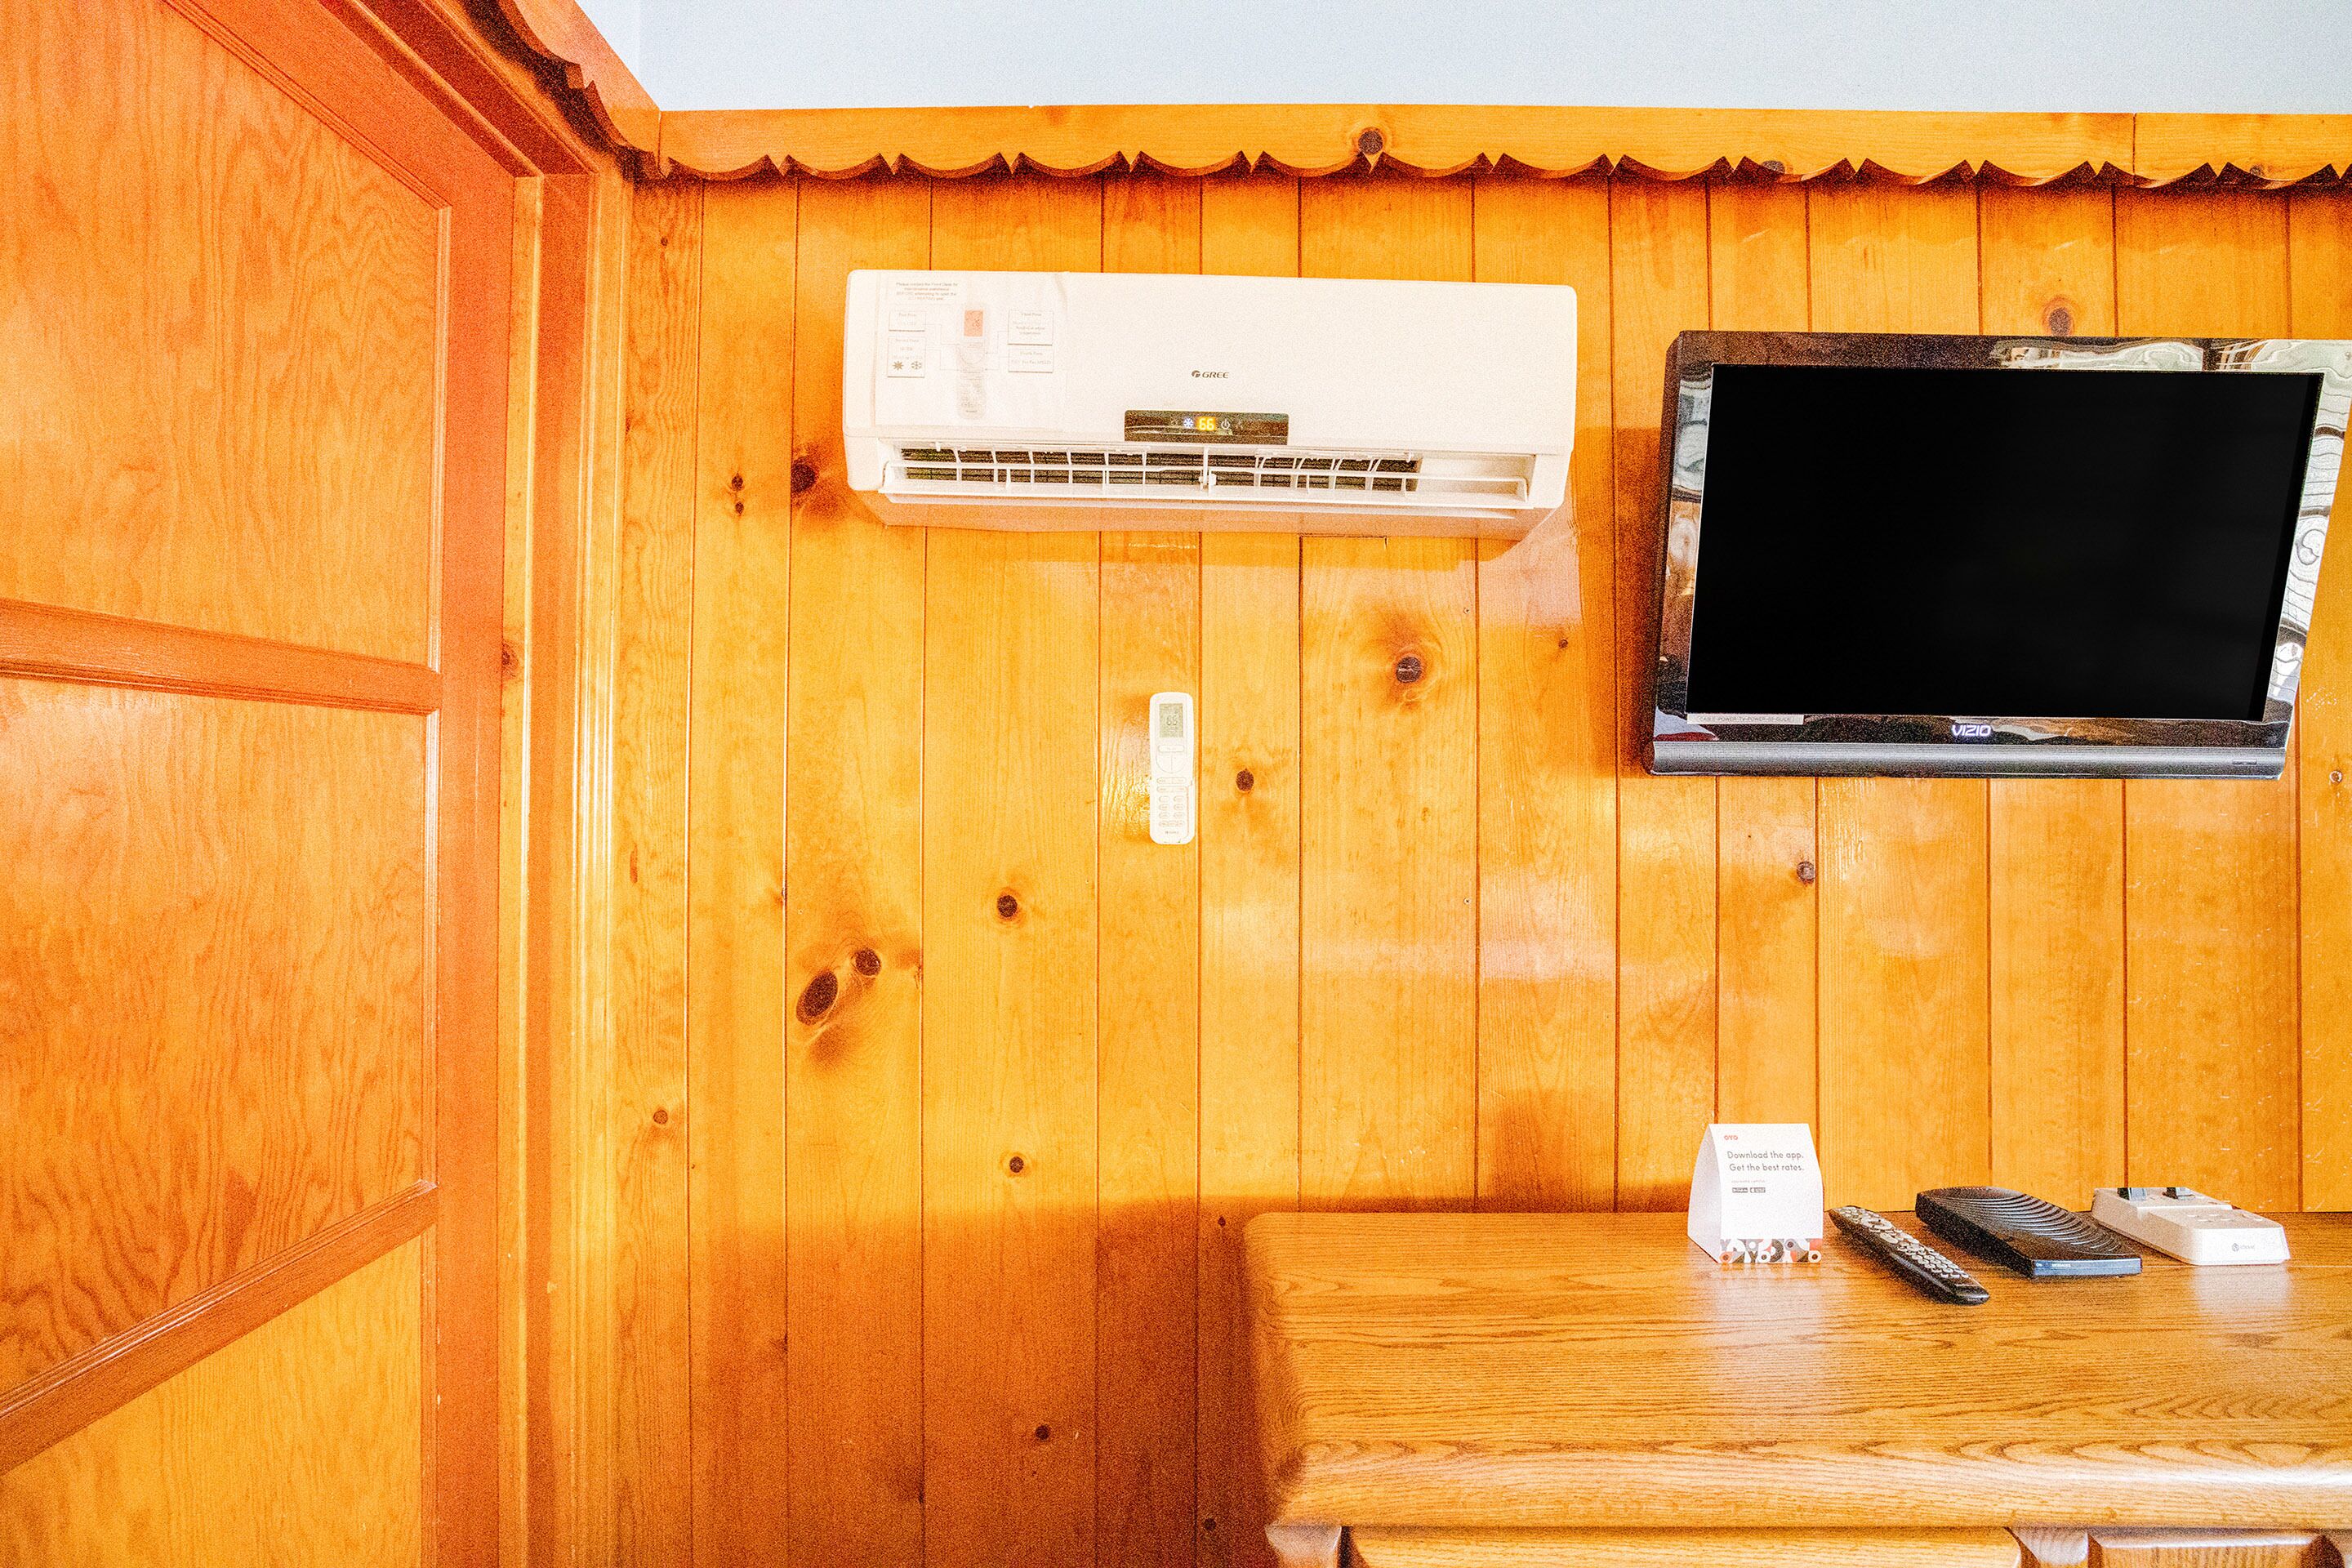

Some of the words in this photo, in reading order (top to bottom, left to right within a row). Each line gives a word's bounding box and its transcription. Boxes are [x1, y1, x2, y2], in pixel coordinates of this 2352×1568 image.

[1199, 417, 1214, 430] 66
[1952, 724, 1991, 737] VIZIO
[1727, 1151, 1768, 1159] Download
[1770, 1151, 1784, 1159] the
[1785, 1152, 1804, 1160] app.
[1729, 1163, 1744, 1171] Get
[1747, 1163, 1760, 1171] the
[1762, 1163, 1780, 1171] best
